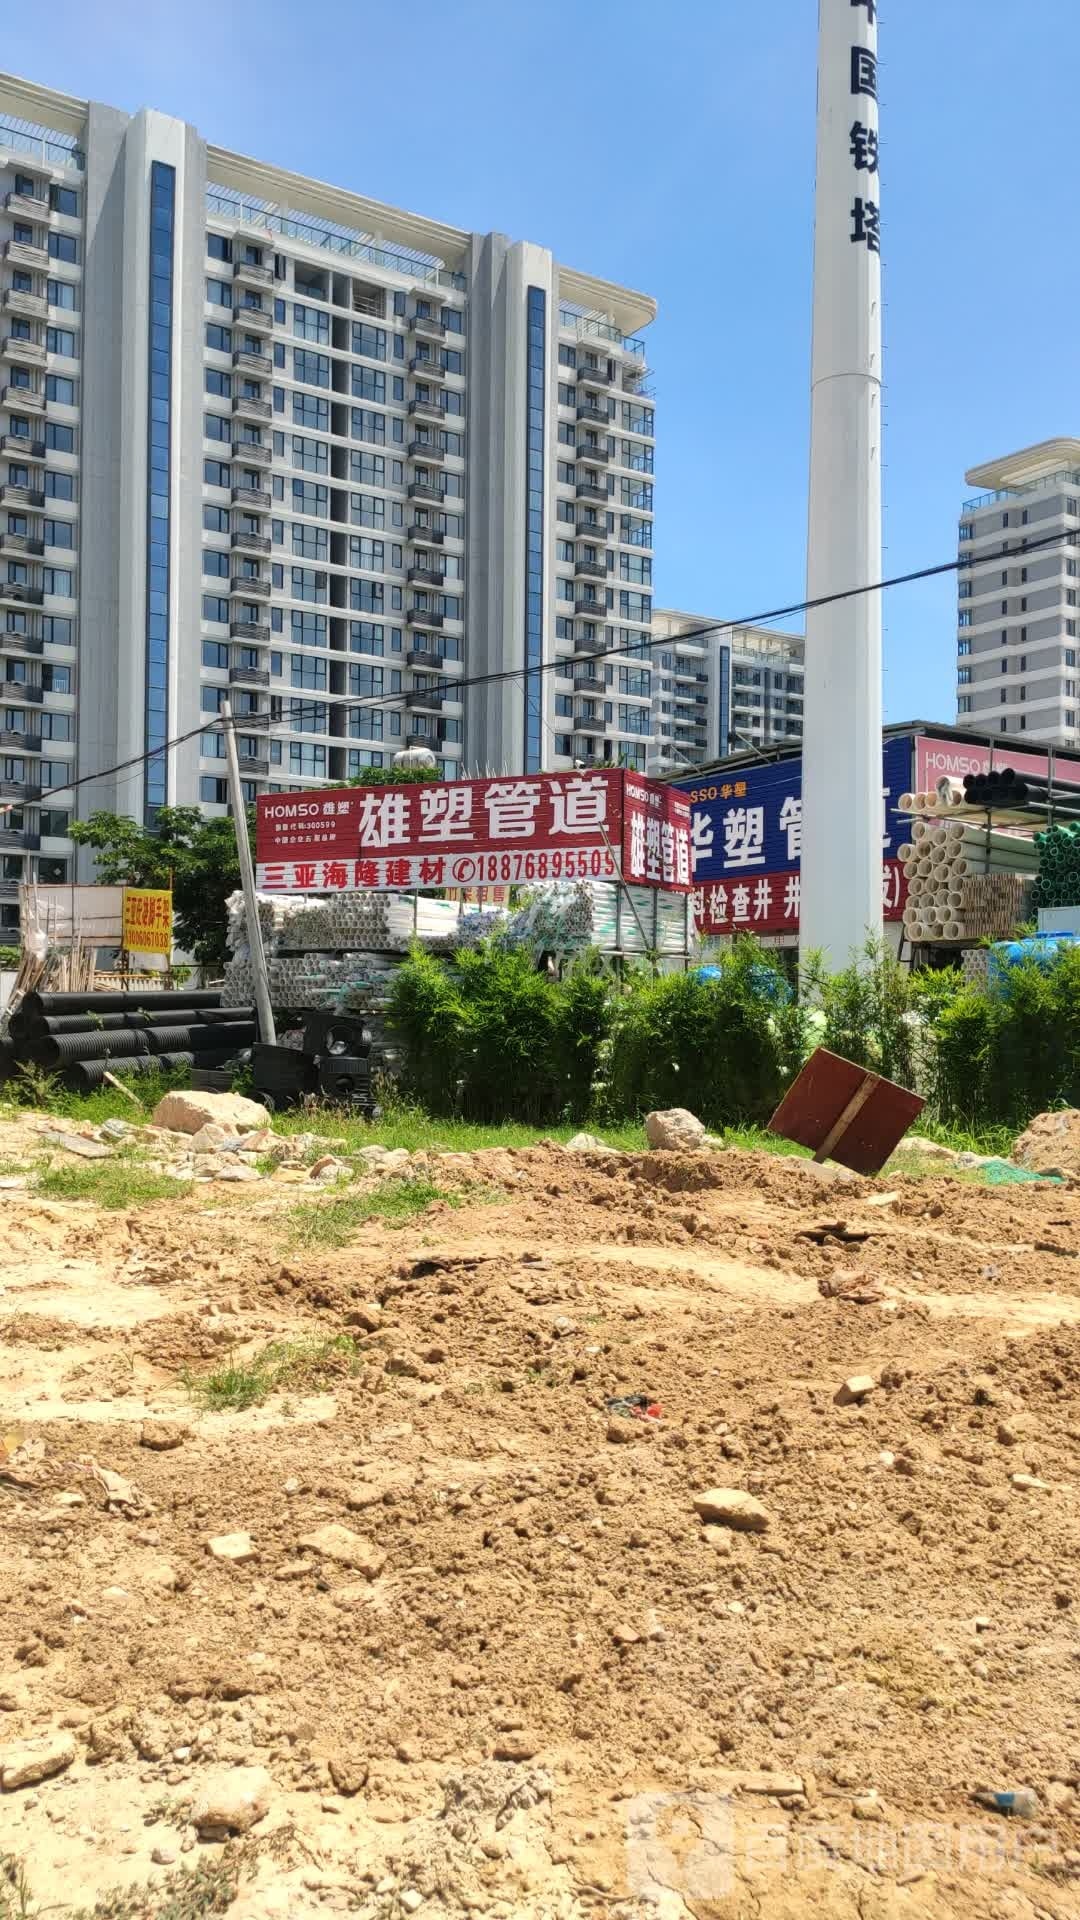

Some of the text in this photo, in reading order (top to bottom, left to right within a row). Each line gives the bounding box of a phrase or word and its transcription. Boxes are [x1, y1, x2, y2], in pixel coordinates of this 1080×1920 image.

[926, 752, 980, 774] HOMSO
[626, 783, 649, 802] HOMSO
[264, 803, 320, 819] HOMSO
[358, 776, 610, 848] 雄塑管道
[631, 810, 690, 885] 雄塑管道
[262, 859, 447, 890] 三亚海隆建材
